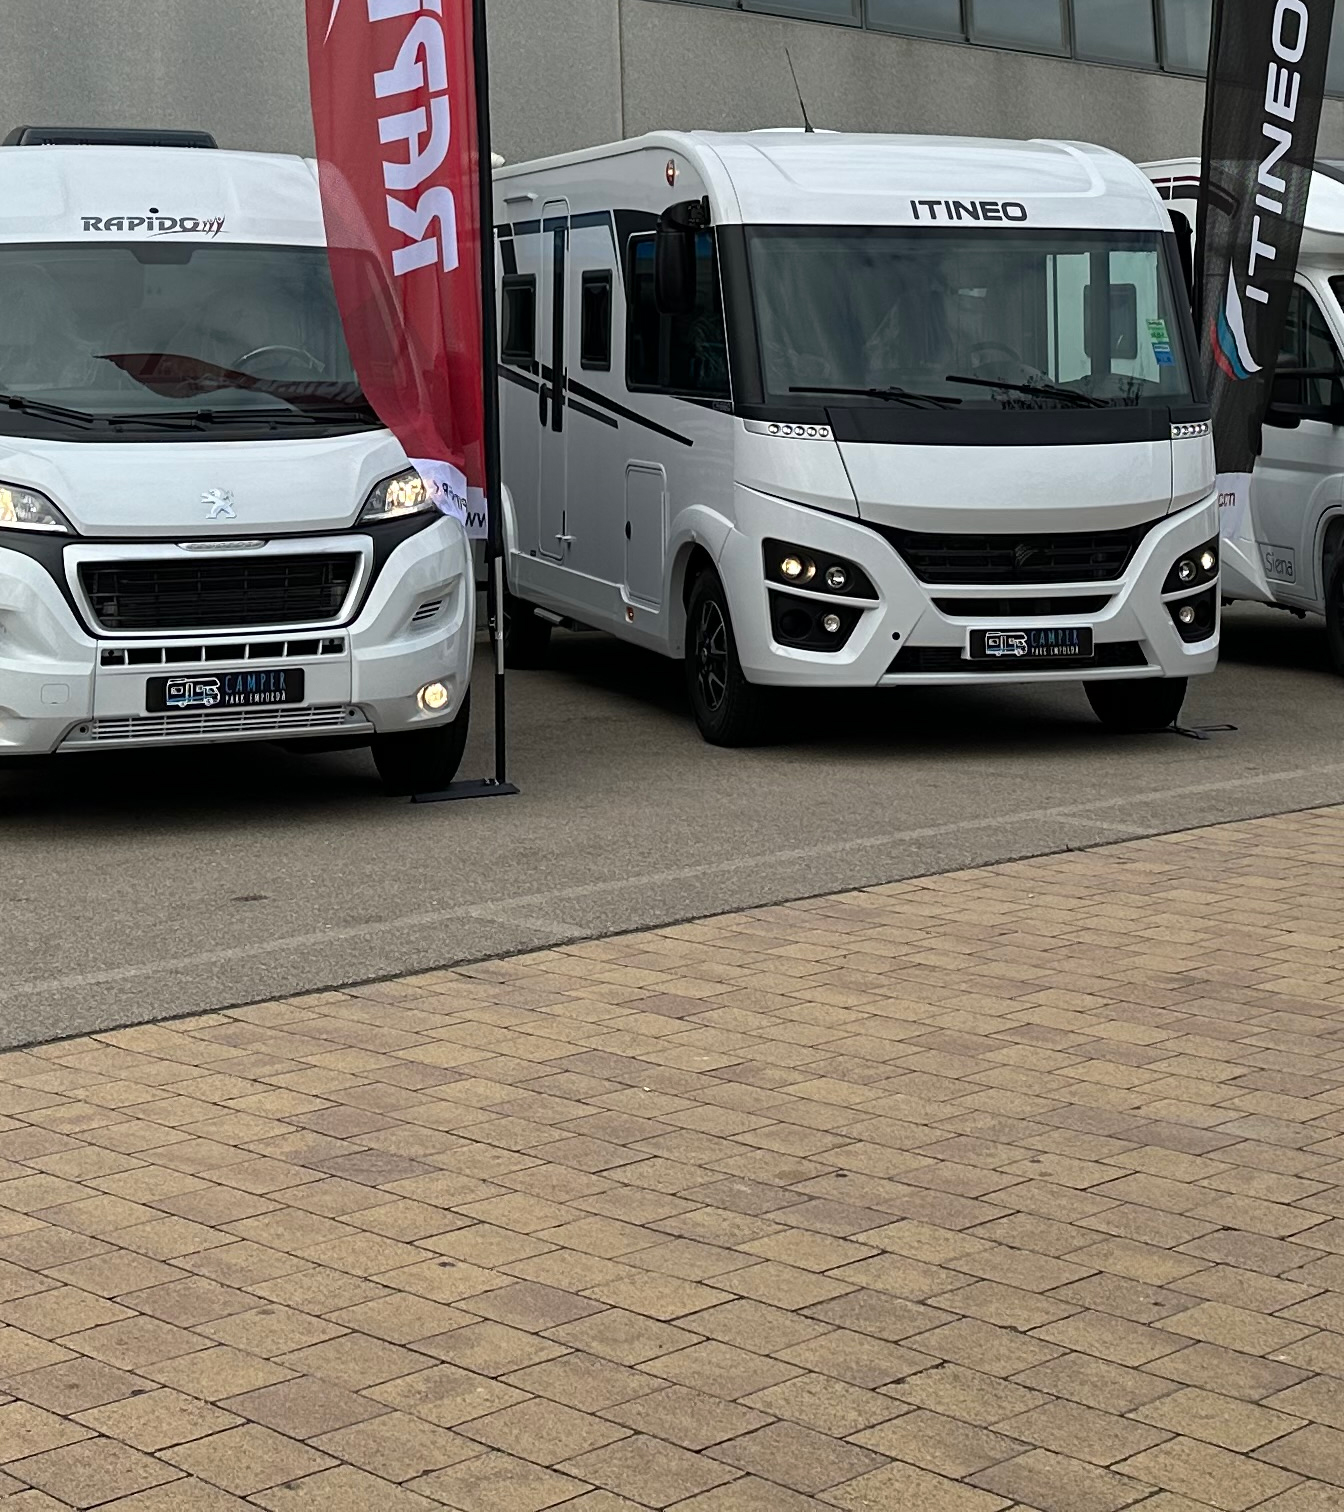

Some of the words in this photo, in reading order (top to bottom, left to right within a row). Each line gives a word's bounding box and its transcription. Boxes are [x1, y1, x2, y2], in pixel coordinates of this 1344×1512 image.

[909, 199, 1028, 222] ITINEO
[1265, 552, 1293, 577] Siena
[1030, 629, 1079, 647] CAMPER
[225, 671, 287, 694] CAMPER
